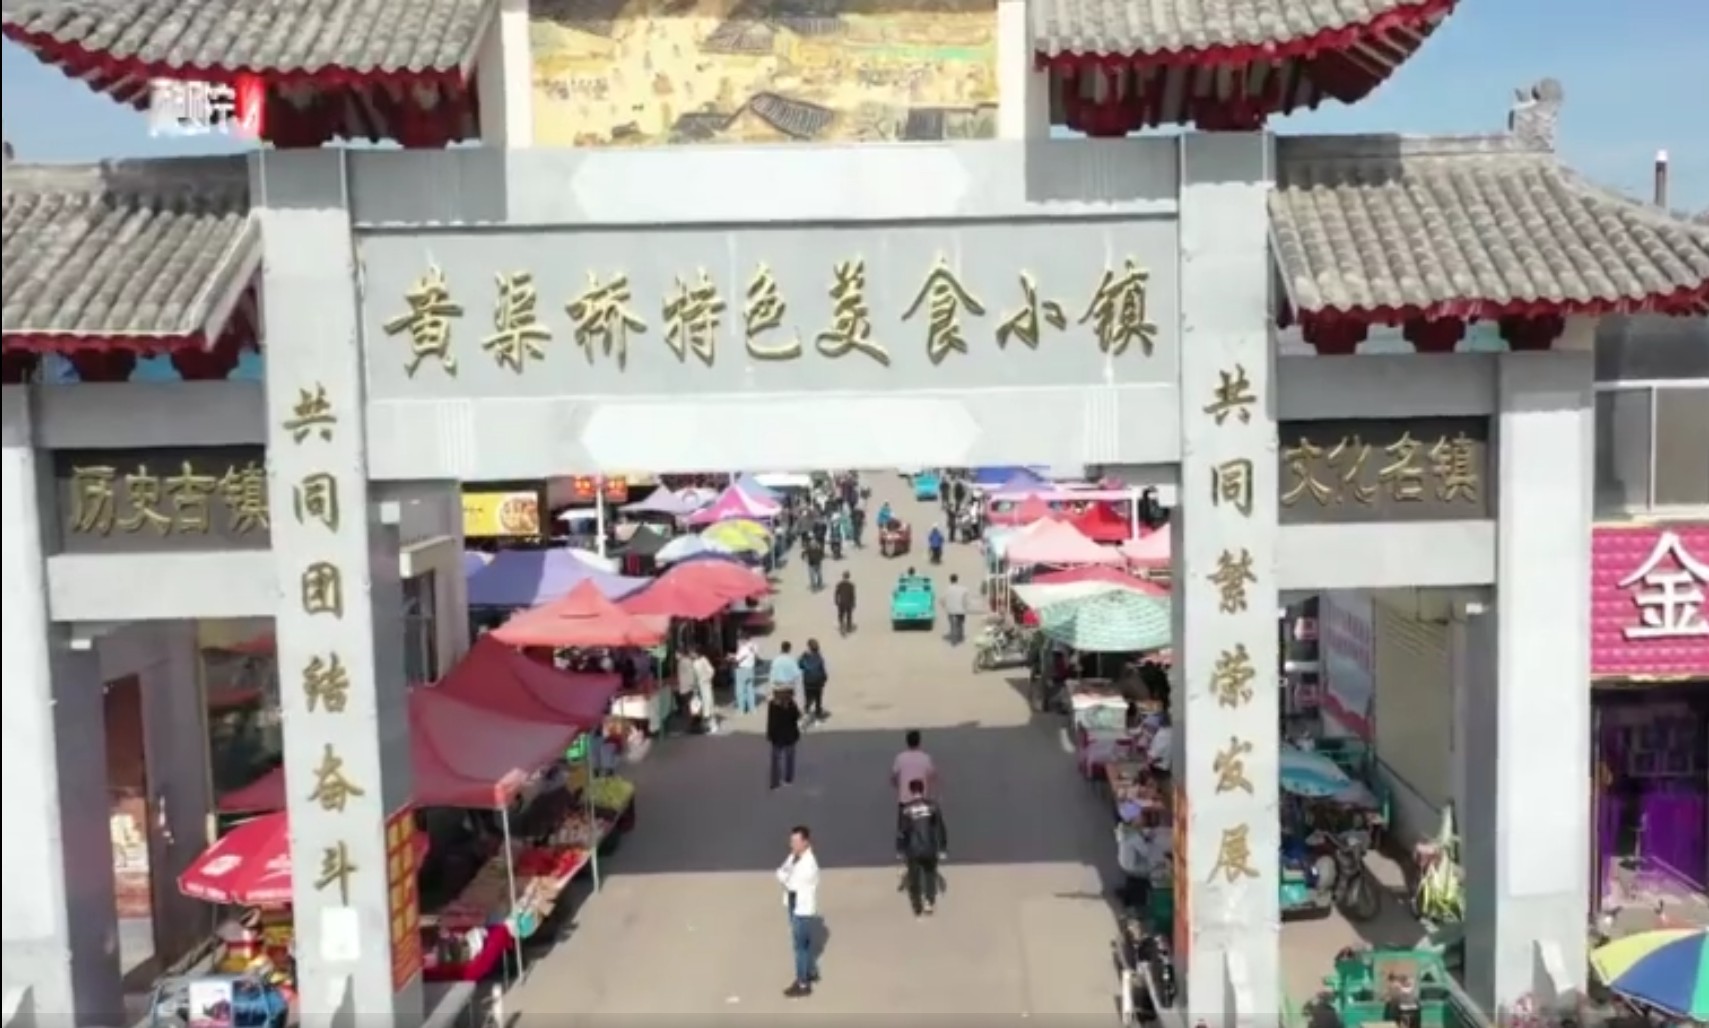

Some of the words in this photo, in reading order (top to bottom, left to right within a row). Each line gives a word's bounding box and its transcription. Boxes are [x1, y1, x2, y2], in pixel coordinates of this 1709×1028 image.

[384, 258, 1158, 377] 黄渠桥特色美食小镇
[71, 460, 269, 538] 历史古镇
[1281, 431, 1478, 506] 文化名镇
[1203, 365, 1259, 884] 共同繁荣发展
[1617, 531, 1709, 640] 金
[284, 382, 363, 905] 共同团结奋斗
